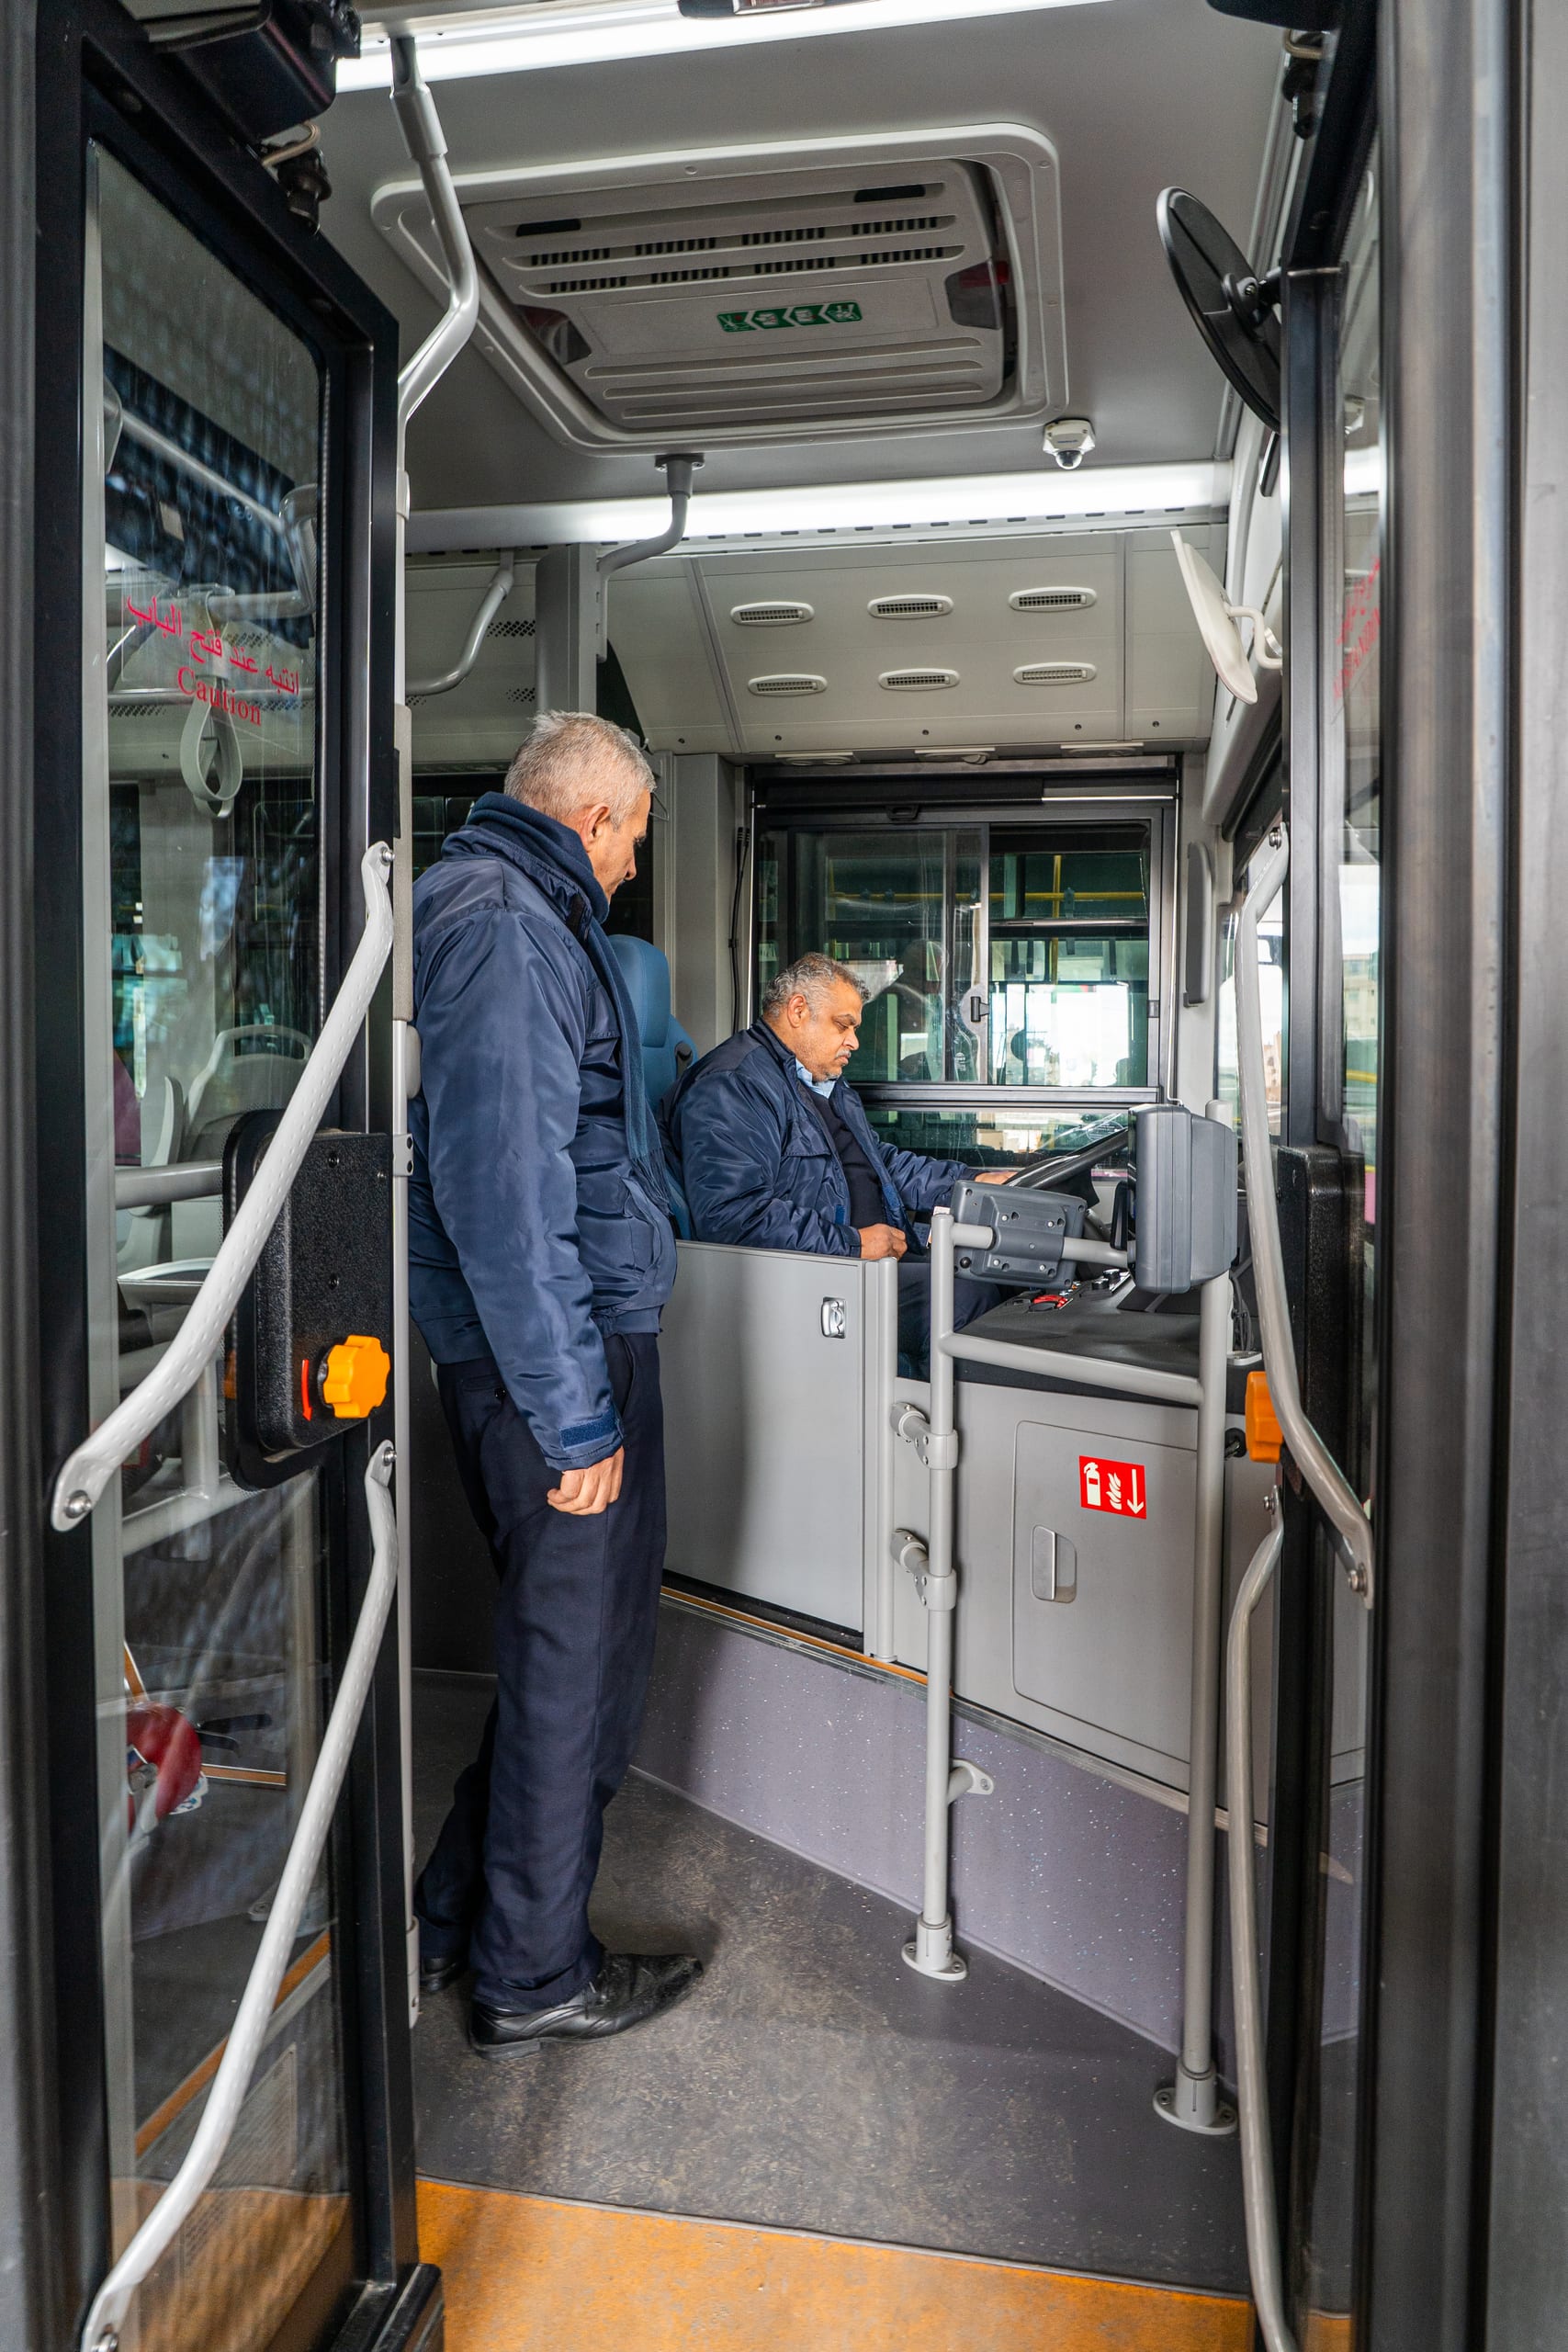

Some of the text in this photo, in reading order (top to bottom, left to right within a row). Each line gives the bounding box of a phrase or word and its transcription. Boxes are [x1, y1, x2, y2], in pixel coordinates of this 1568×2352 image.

[127, 595, 299, 695] انتبه عند فتح الباب
[177, 667, 262, 726] Caution
